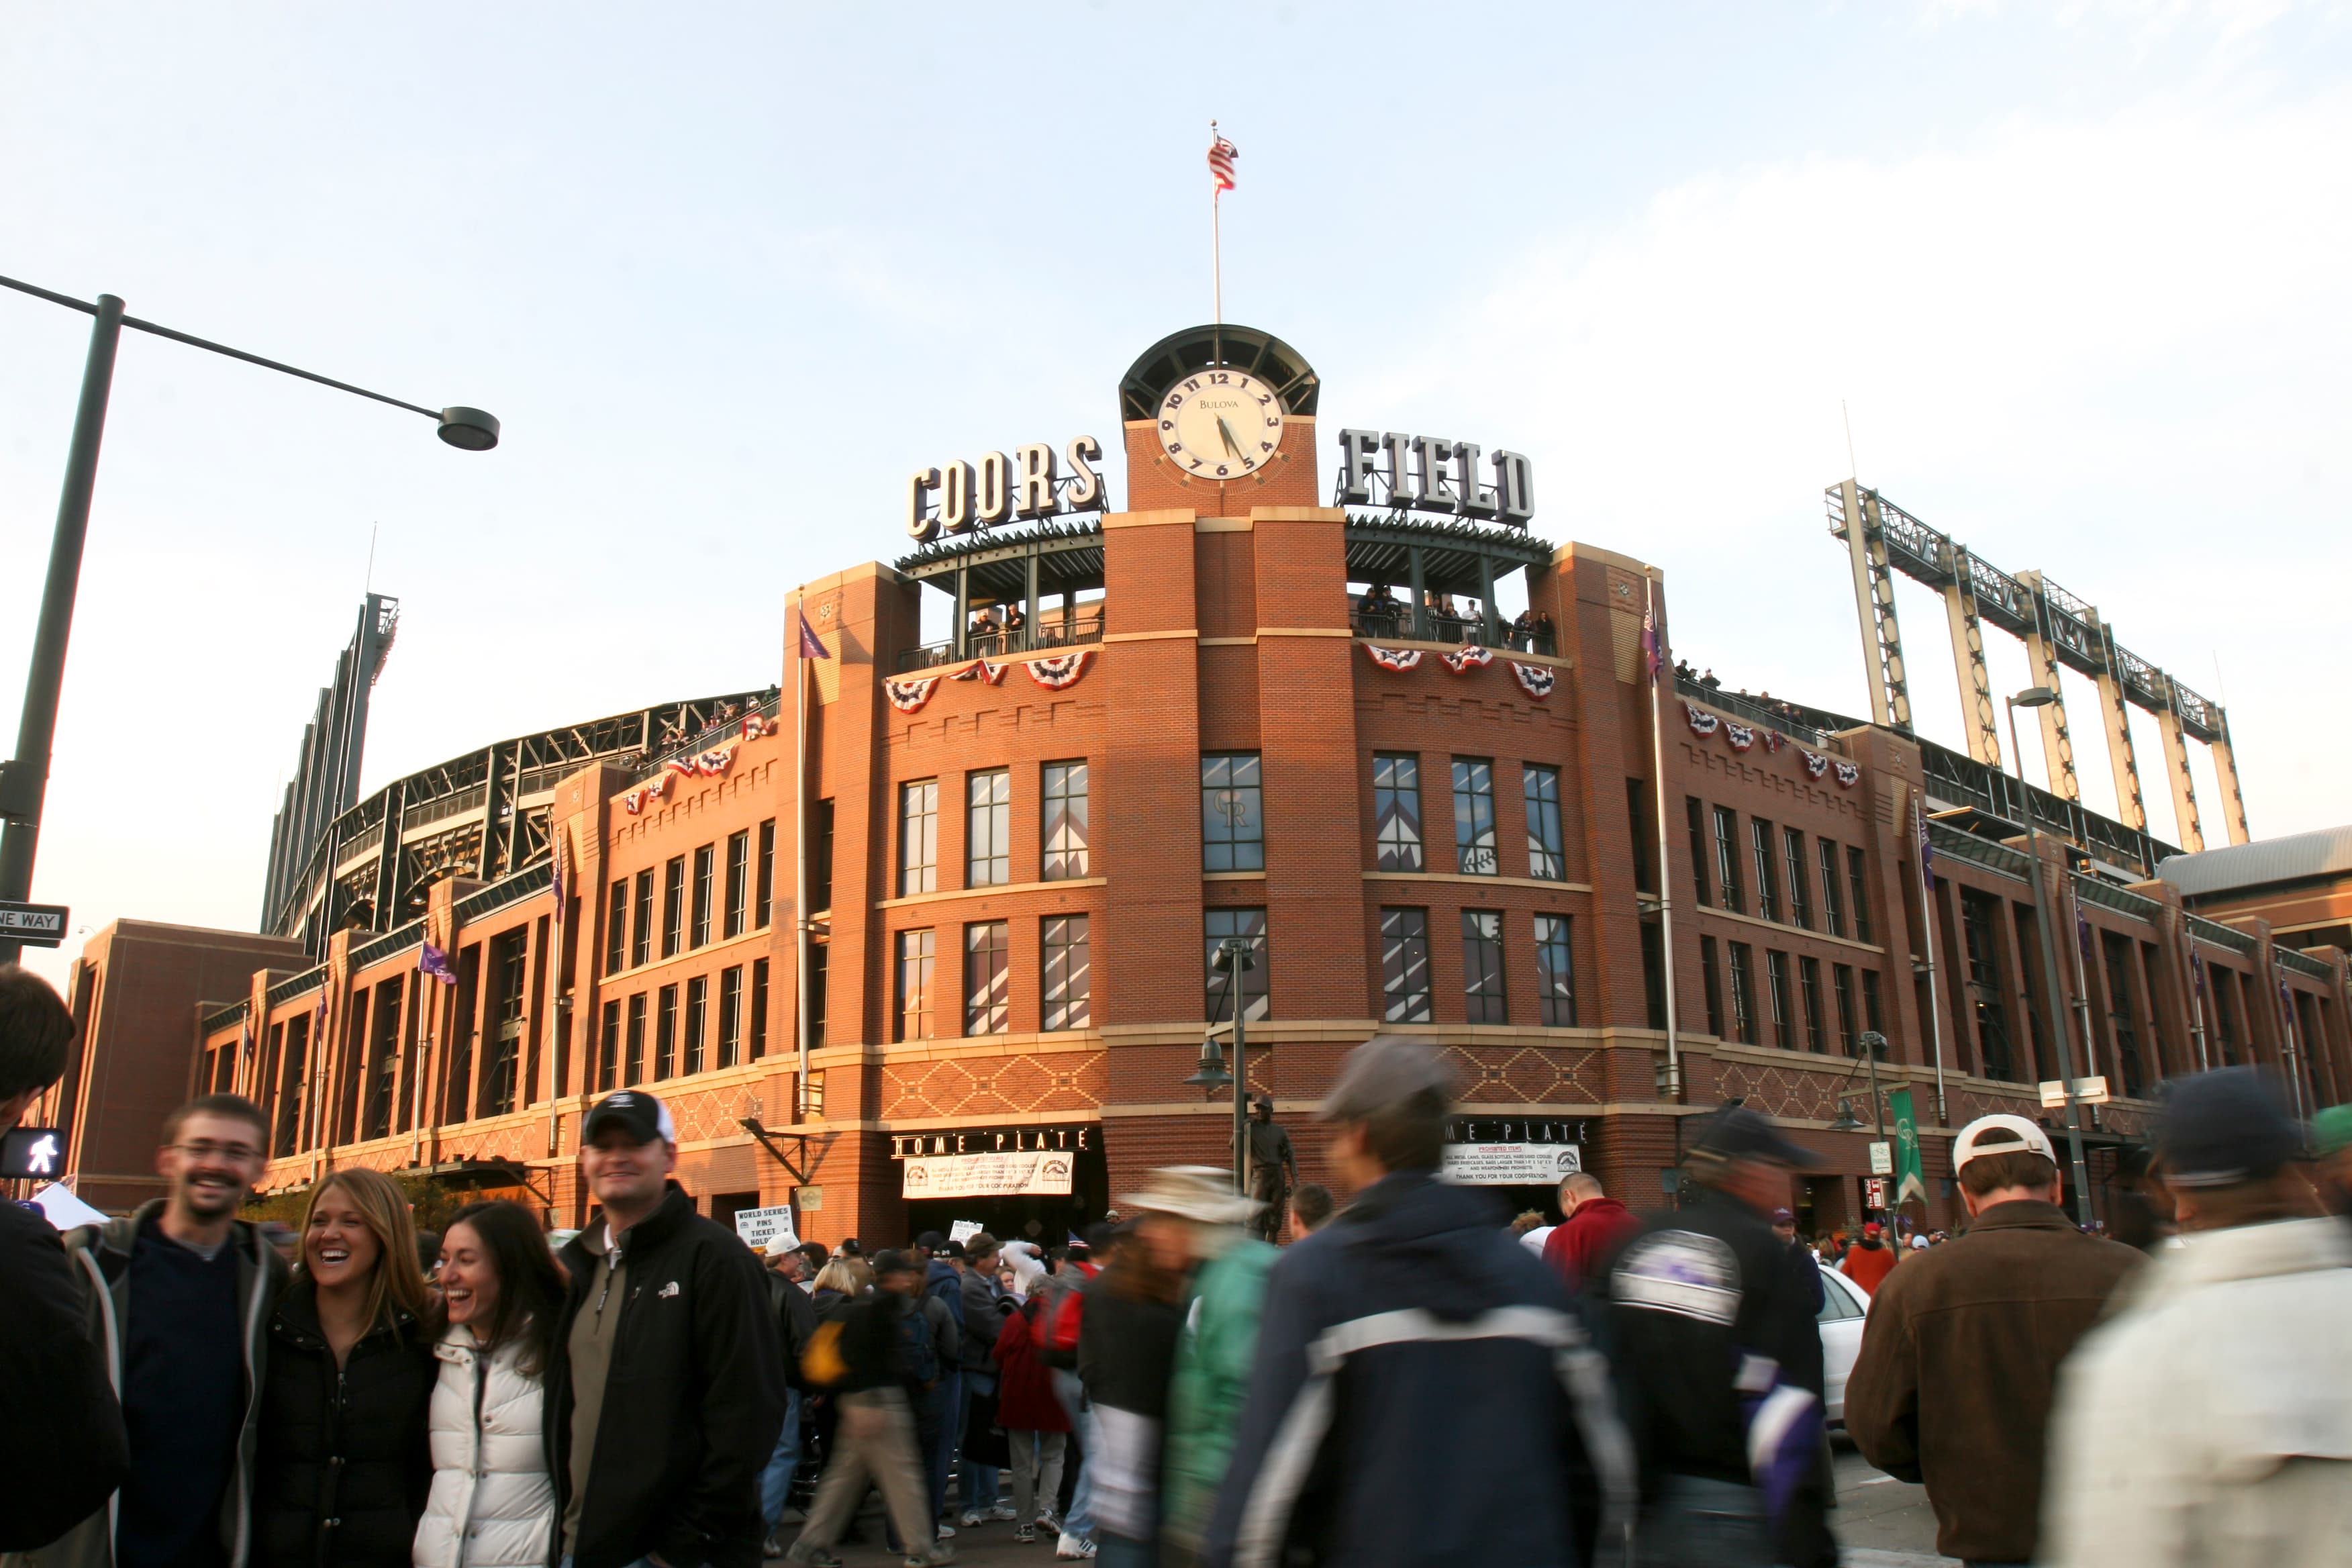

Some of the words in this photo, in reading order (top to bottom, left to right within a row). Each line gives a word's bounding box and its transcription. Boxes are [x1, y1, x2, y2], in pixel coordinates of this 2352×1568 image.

[1209, 373, 1228, 384] 12
[1240, 378, 1249, 388] 1
[1184, 379, 1200, 392] 11
[1166, 394, 1183, 409] 10
[1257, 394, 1271, 406] 2
[1161, 420, 1174, 430] 9
[1267, 418, 1279, 427] 3
[1169, 442, 1181, 454] 8
[1261, 441, 1273, 452] 4
[1189, 458, 1203, 470] 7
[1244, 456, 1255, 470] 5
[1216, 464, 1228, 476] 6
[908, 435, 1101, 543] COORS
[1339, 428, 1534, 522] FIELD
[0, 912, 15, 925] NE
[22, 914, 55, 928] WAY
[1505, 1124, 1585, 1140] PLATE
[895, 1136, 965, 1156] HOME
[997, 1131, 1085, 1150] PLATE
[739, 1211, 762, 1219] WORLD
[763, 1208, 788, 1216] SERIES
[751, 1228, 776, 1236] TICKET
[750, 1238, 771, 1246] HOLD
